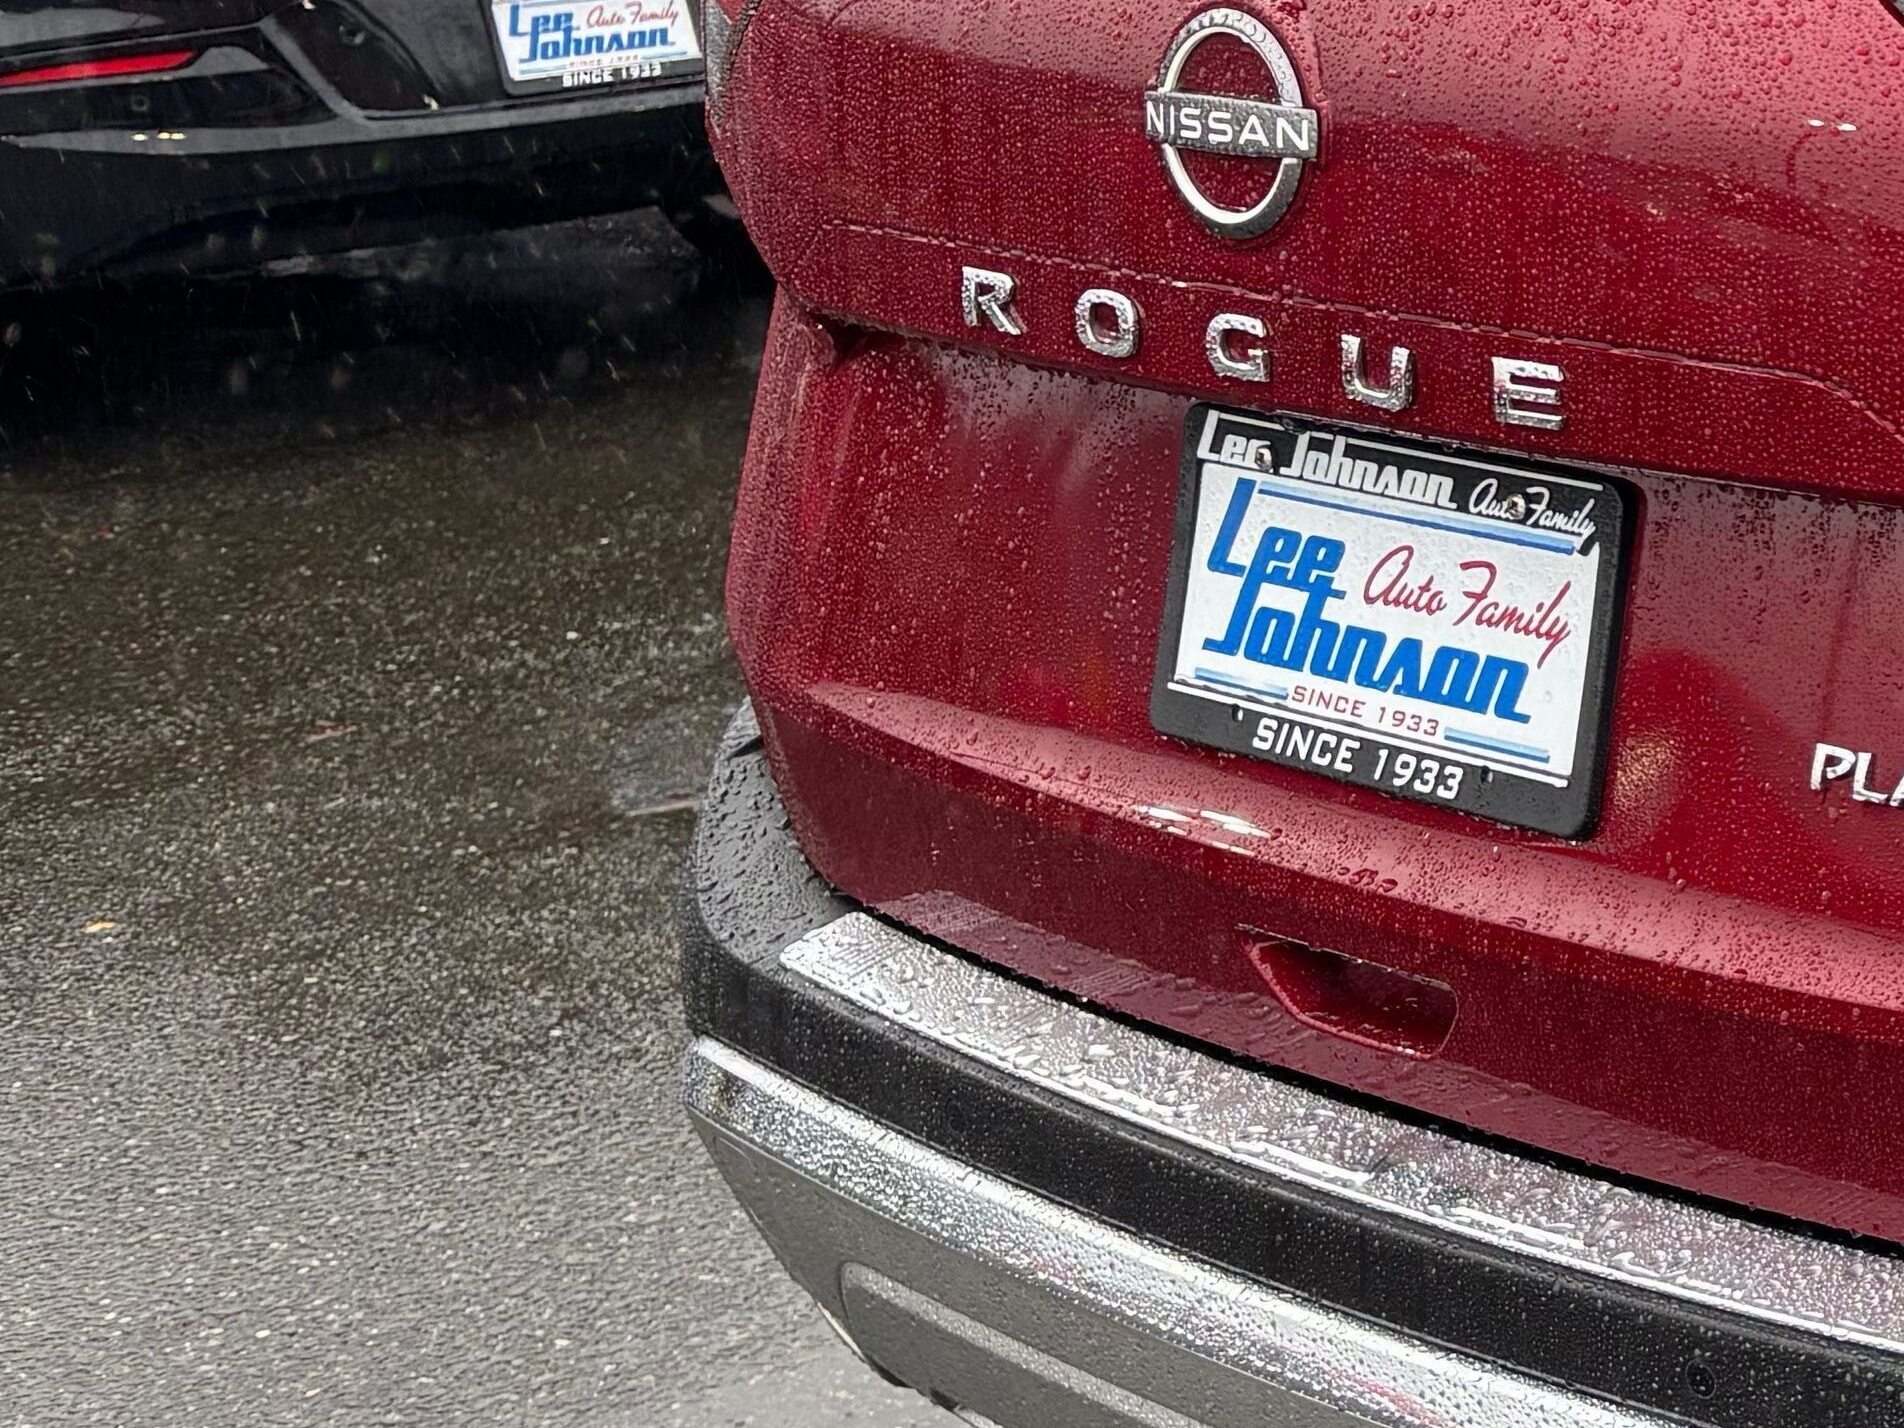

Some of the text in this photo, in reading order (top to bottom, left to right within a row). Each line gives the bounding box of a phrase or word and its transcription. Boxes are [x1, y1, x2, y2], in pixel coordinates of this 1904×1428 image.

[509, 4, 580, 37] Lee
[625, 0, 679, 26] Family
[519, 25, 676, 64] Johnson
[562, 62, 662, 87] SINCE 1933
[1146, 99, 1311, 152] NISSAN
[961, 265, 1566, 430] ROGUE
[1279, 430, 1458, 510] Johnson
[1469, 478, 1526, 520] Aut
[1525, 486, 1597, 551] Family
[1207, 478, 1572, 669] Lee Auto Family
[1201, 575, 1532, 725] Johnson
[1291, 685, 1441, 737] SINCE 1933
[1252, 717, 1465, 801] SINCE 1933
